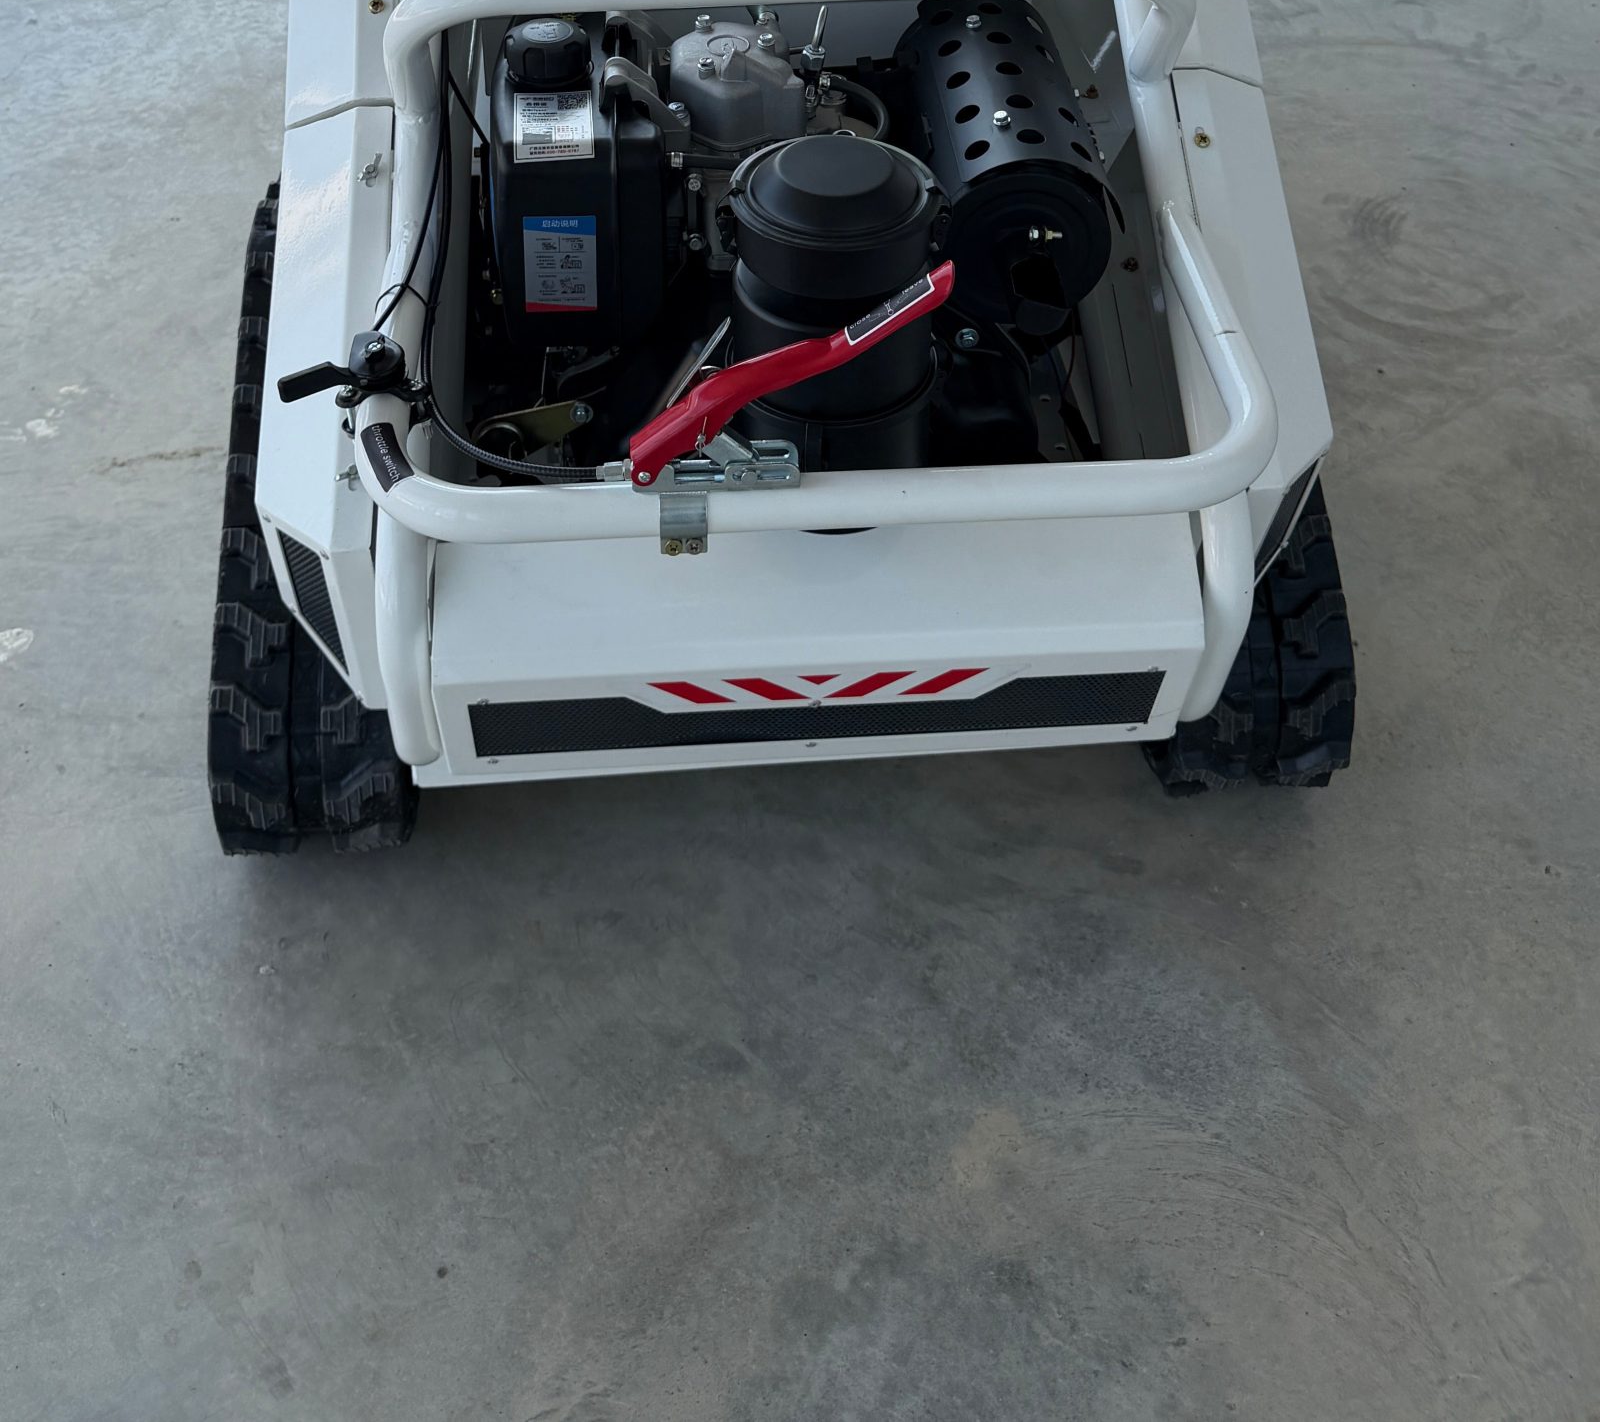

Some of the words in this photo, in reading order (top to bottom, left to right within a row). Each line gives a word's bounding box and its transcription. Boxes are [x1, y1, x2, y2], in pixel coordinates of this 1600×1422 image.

[542, 219, 579, 228] 启动说明
[902, 278, 923, 295] leave
[849, 313, 871, 330] close
[372, 425, 390, 454] throttle
[383, 455, 401, 482] switch
